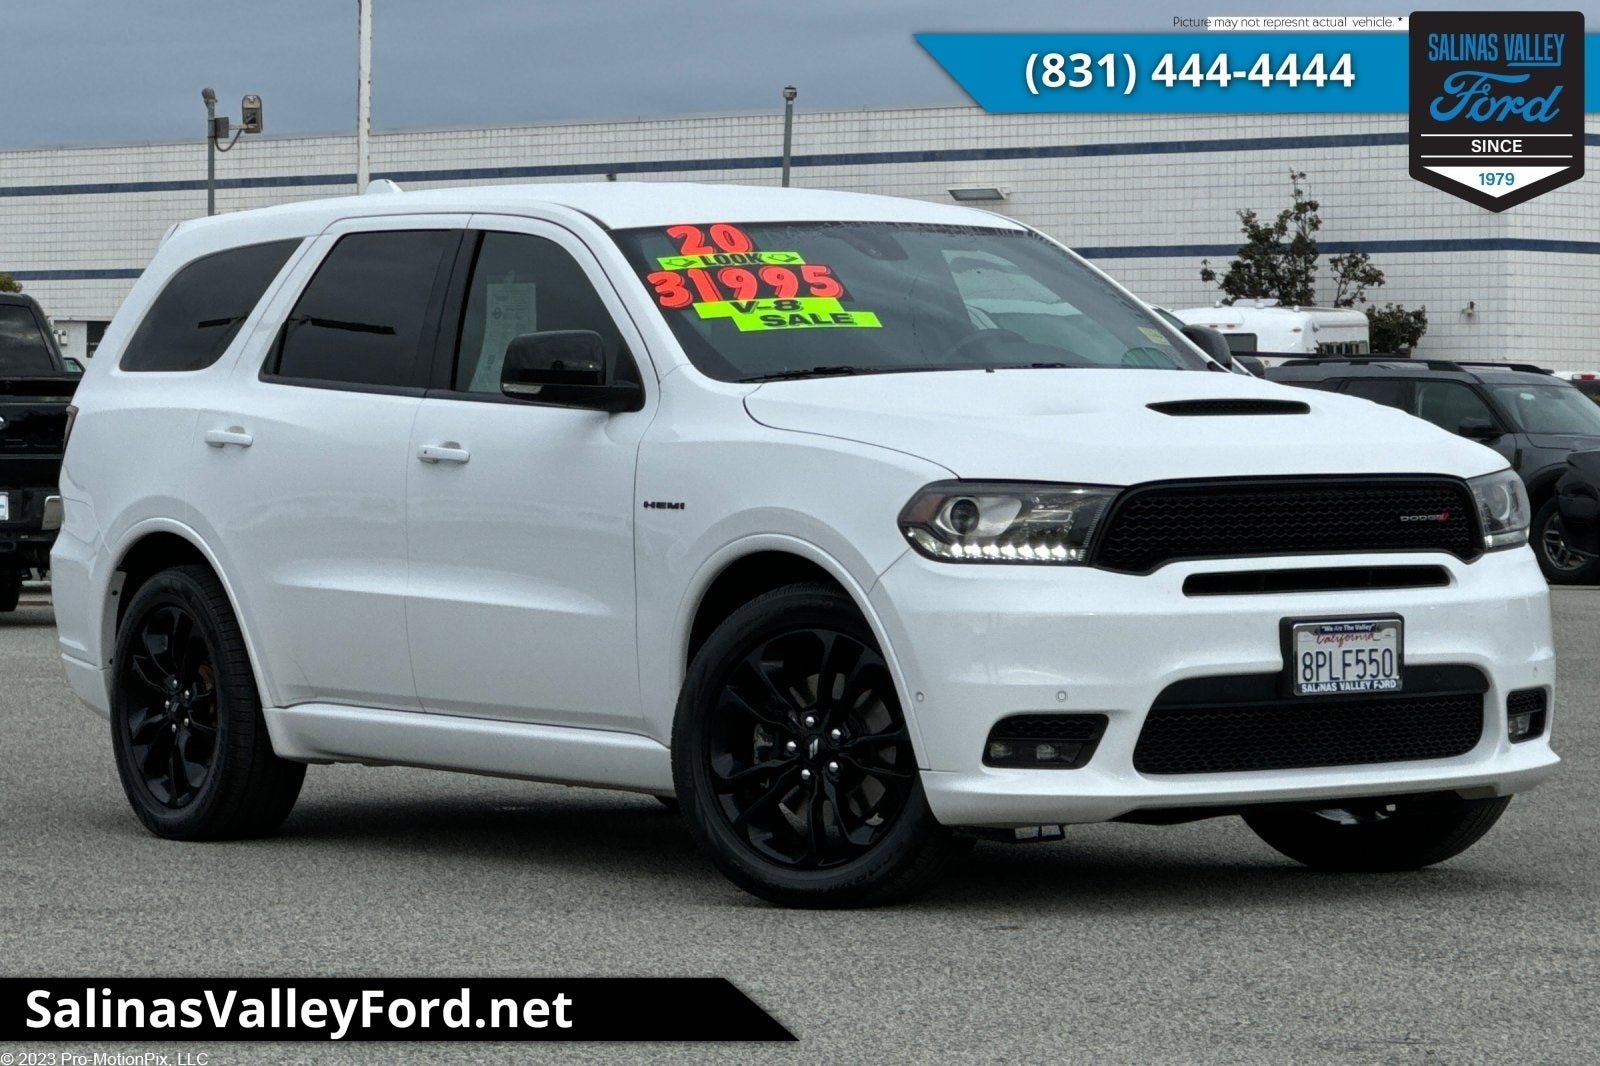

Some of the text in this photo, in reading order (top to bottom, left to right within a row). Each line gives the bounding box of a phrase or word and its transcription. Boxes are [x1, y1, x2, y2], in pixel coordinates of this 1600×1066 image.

[666, 222, 752, 255] 20
[700, 251, 764, 266] LOOK
[646, 263, 844, 309] 31995
[729, 299, 801, 314] V-8
[759, 312, 856, 328] SALE
[643, 500, 686, 510] HEMI
[1302, 648, 1393, 682] 8PLF550
[1301, 679, 1397, 693] SALINAS VALLEY FORD
